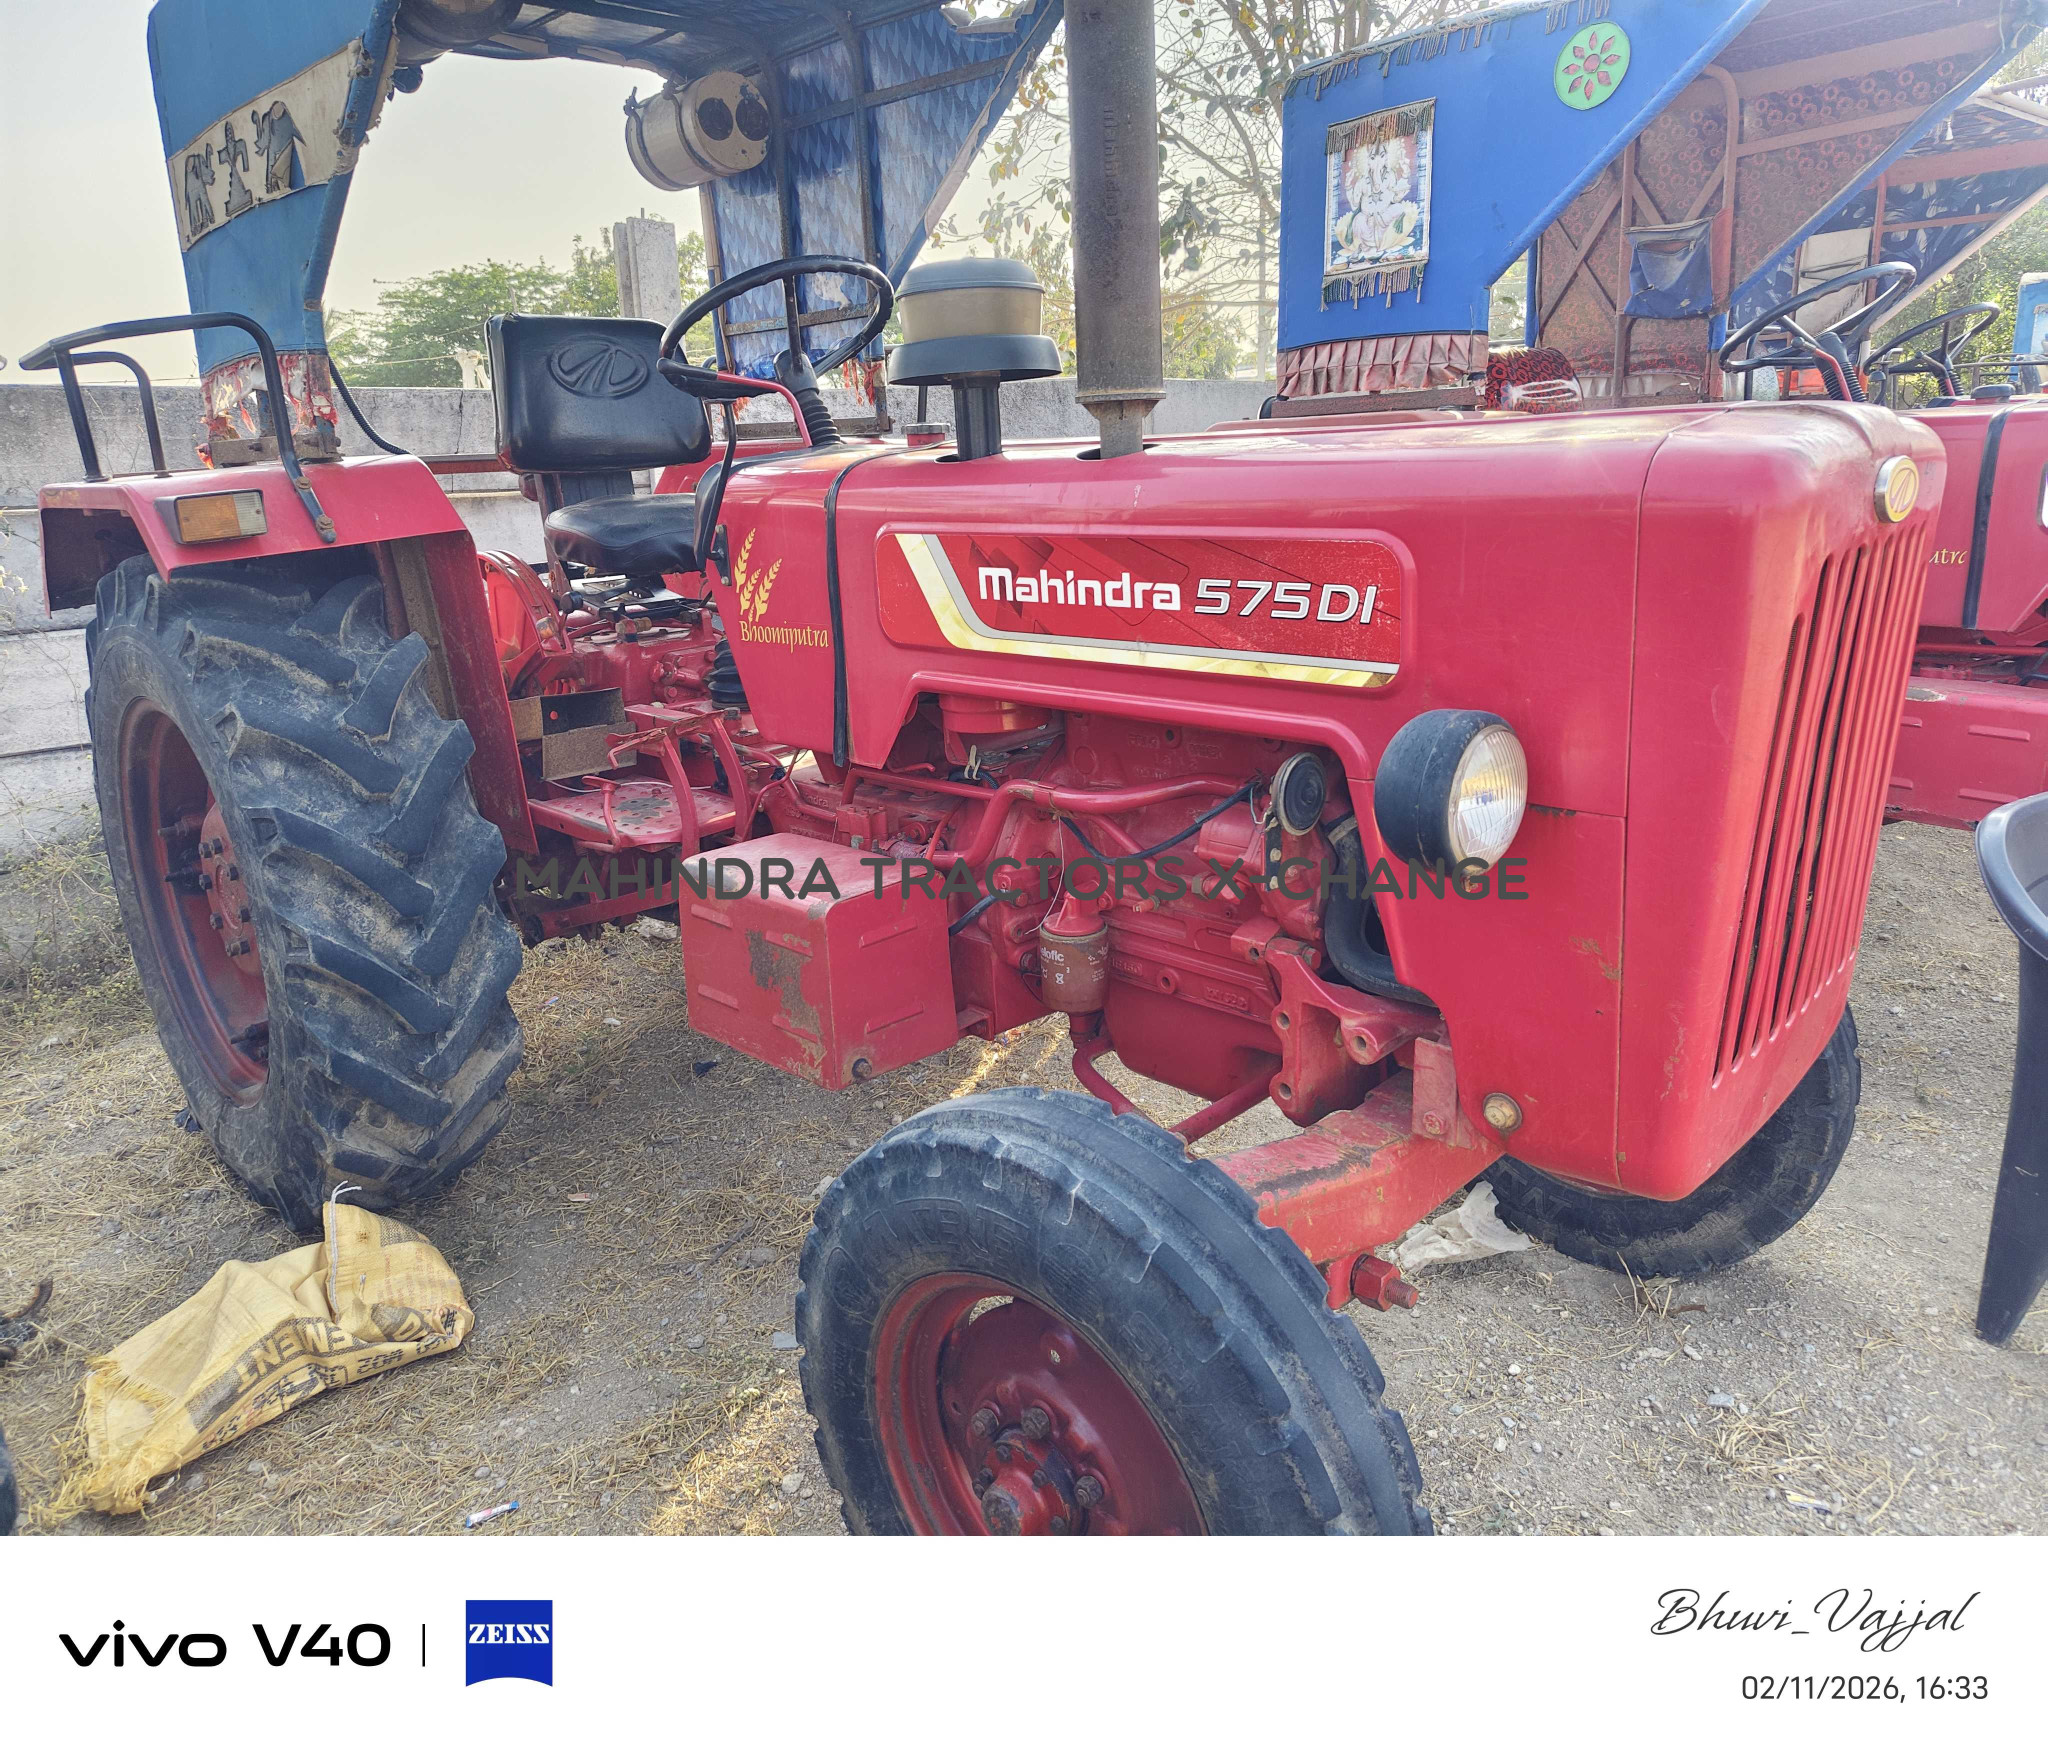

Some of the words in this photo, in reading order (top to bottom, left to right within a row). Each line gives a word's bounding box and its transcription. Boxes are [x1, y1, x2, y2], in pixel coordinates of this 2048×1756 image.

[978, 566, 1181, 611] Mahindra
[739, 620, 829, 654] Bhoomiputra
[236, 1321, 353, 1394] EMENT
